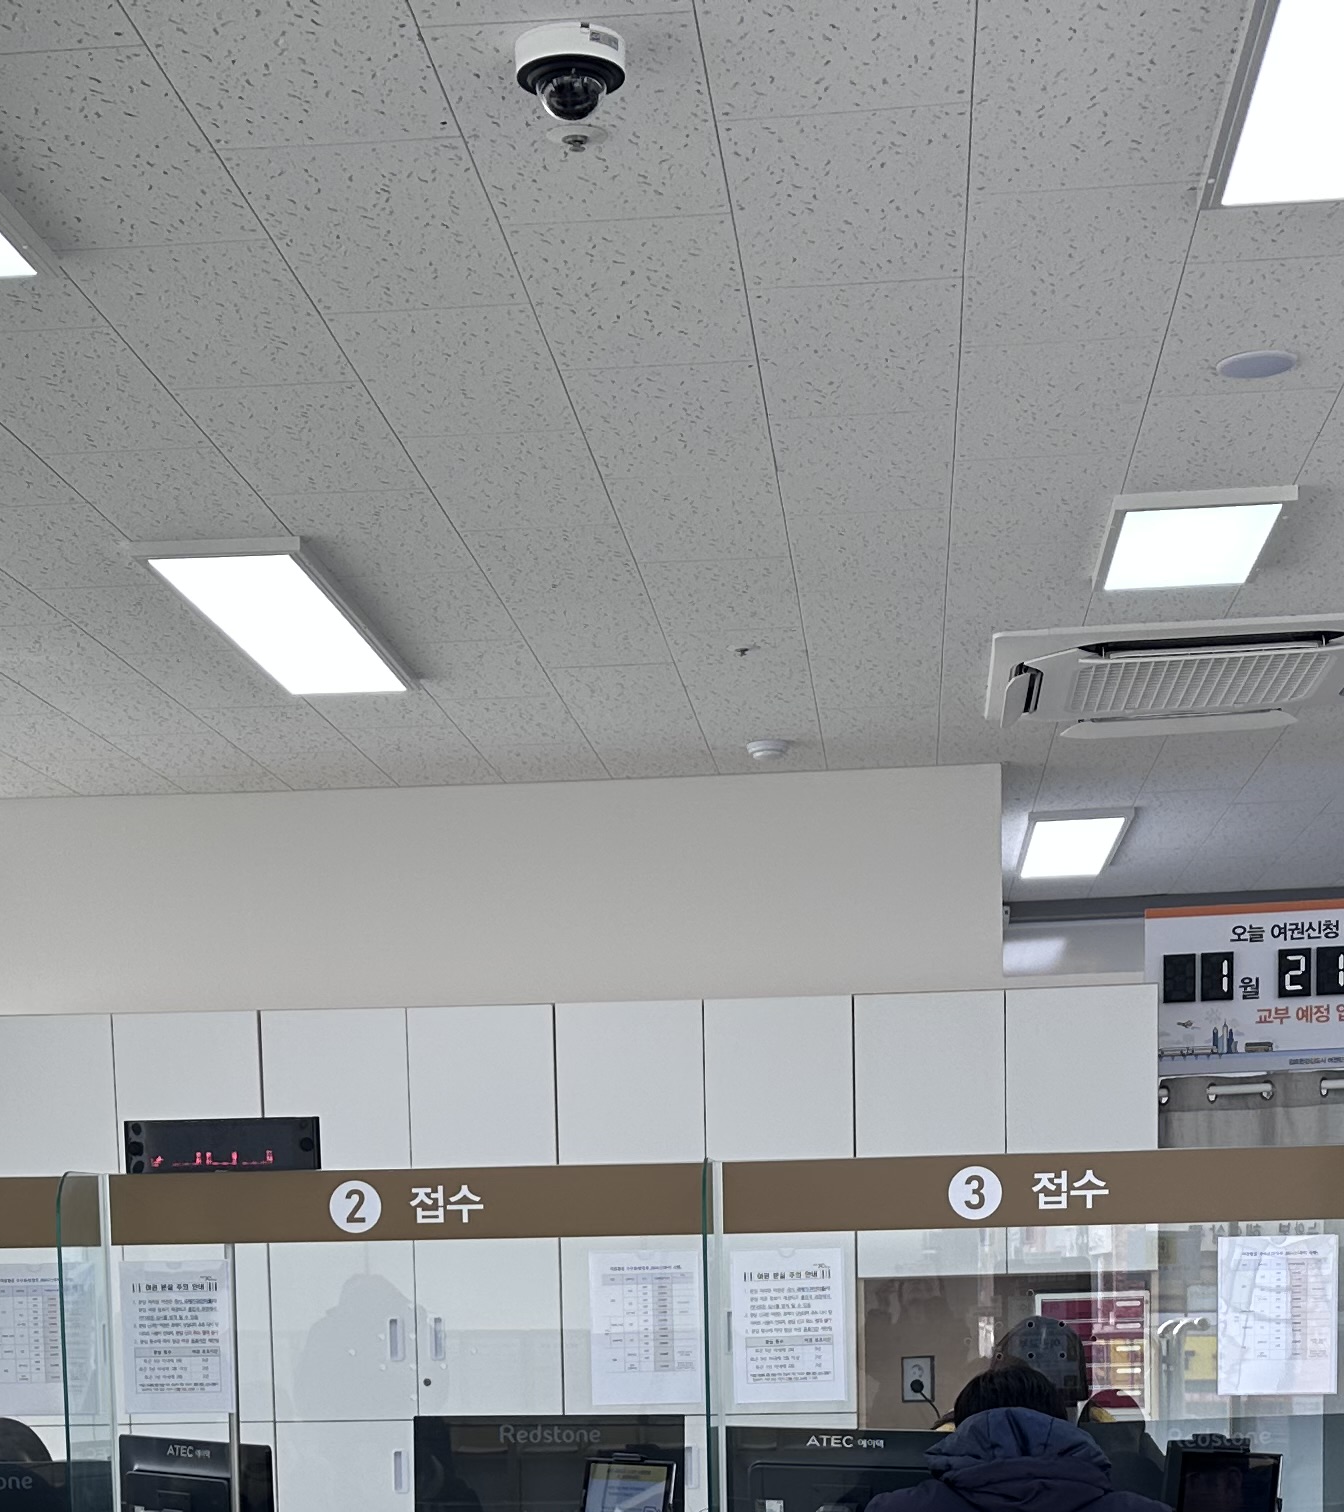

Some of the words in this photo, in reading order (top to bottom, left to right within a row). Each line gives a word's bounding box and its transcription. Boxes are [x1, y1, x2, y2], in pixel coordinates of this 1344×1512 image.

[1230, 925, 1265, 942] 오늘
[1271, 920, 1339, 941] 여권신청
[1256, 1007, 1291, 1024] 교부
[1296, 1004, 1330, 1023] 예정
[964, 1175, 985, 1209] 3
[1032, 1170, 1109, 1209] 접수
[345, 1189, 365, 1223] 2
[410, 1185, 483, 1223] 접수
[498, 1424, 602, 1445] Redstone
[805, 1434, 855, 1448] ATEC
[1167, 1426, 1273, 1448] Redstone
[166, 1444, 194, 1458] ATEC
